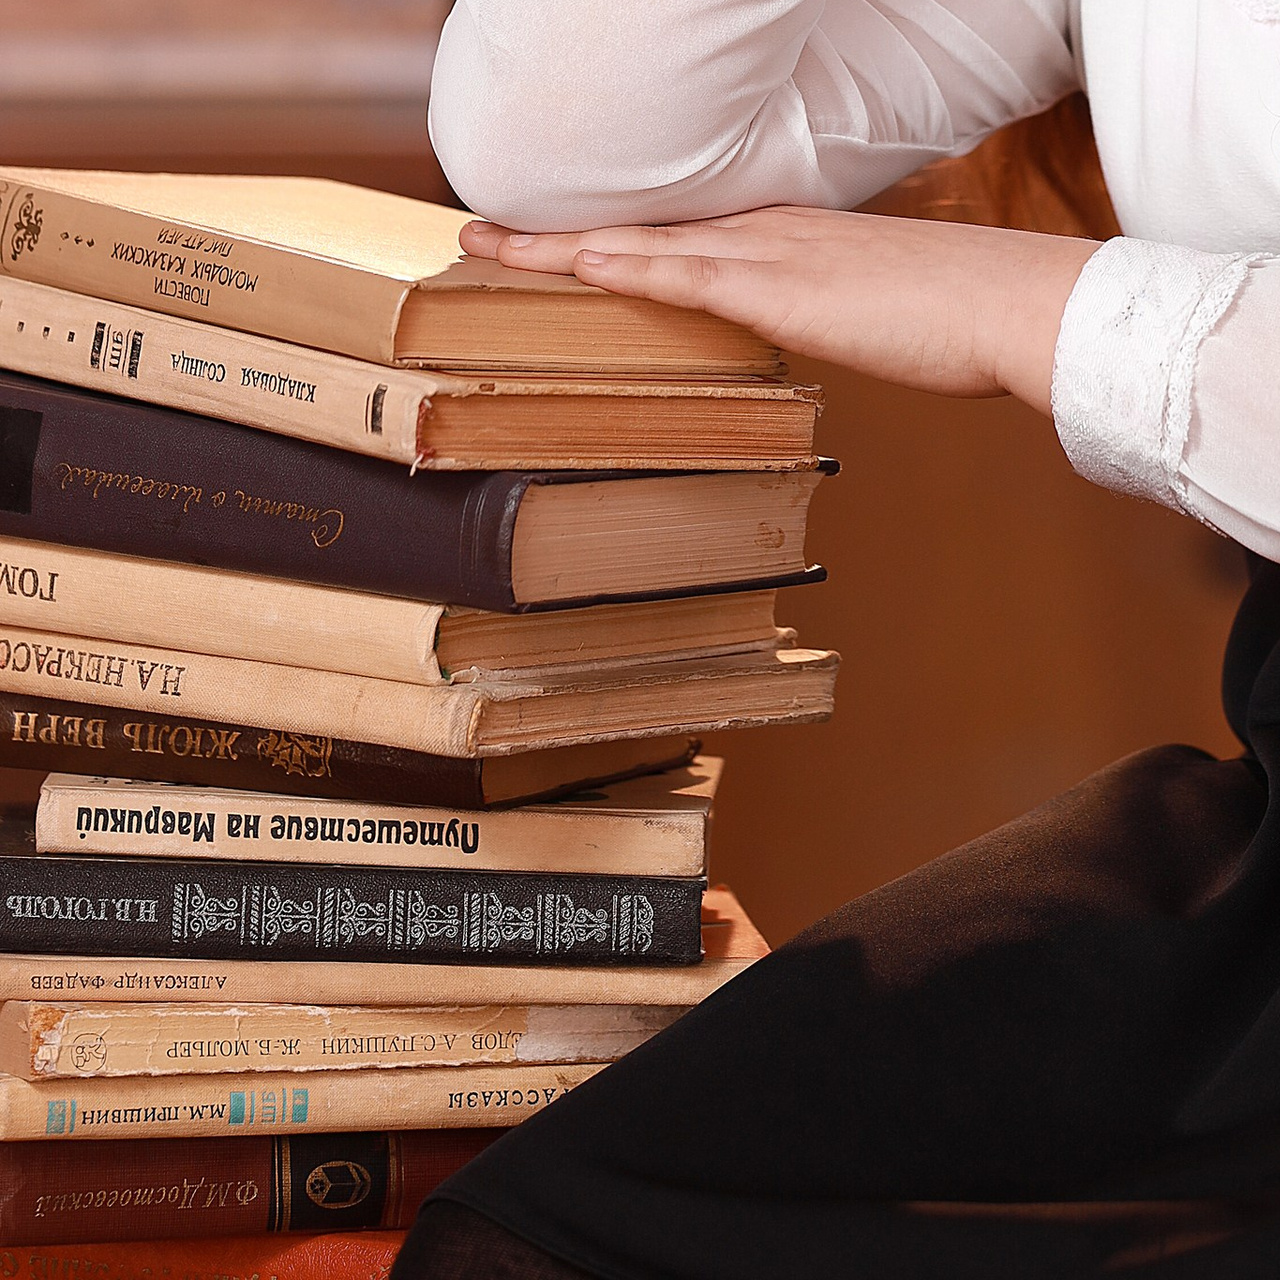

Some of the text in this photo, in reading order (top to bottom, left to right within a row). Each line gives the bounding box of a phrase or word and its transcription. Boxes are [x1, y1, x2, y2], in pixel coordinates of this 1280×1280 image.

[110, 242, 258, 292] МОЛОДЫХ КАЗАХСКИХ
[154, 276, 210, 307] ПОВЕСТИ
[170, 350, 226, 382] СОЛНЦА
[240, 368, 317, 403] КЛАДОВАЯ
[11, 711, 241, 761] ЖЮЛЬ ВЕРН
[75, 805, 480, 855] Путешествие на Маврикий
[30, 973, 228, 990] АЛЕКСАНДР ФАДЕЕВ
[448, 1087, 570, 1109] АССКАЗЫ
